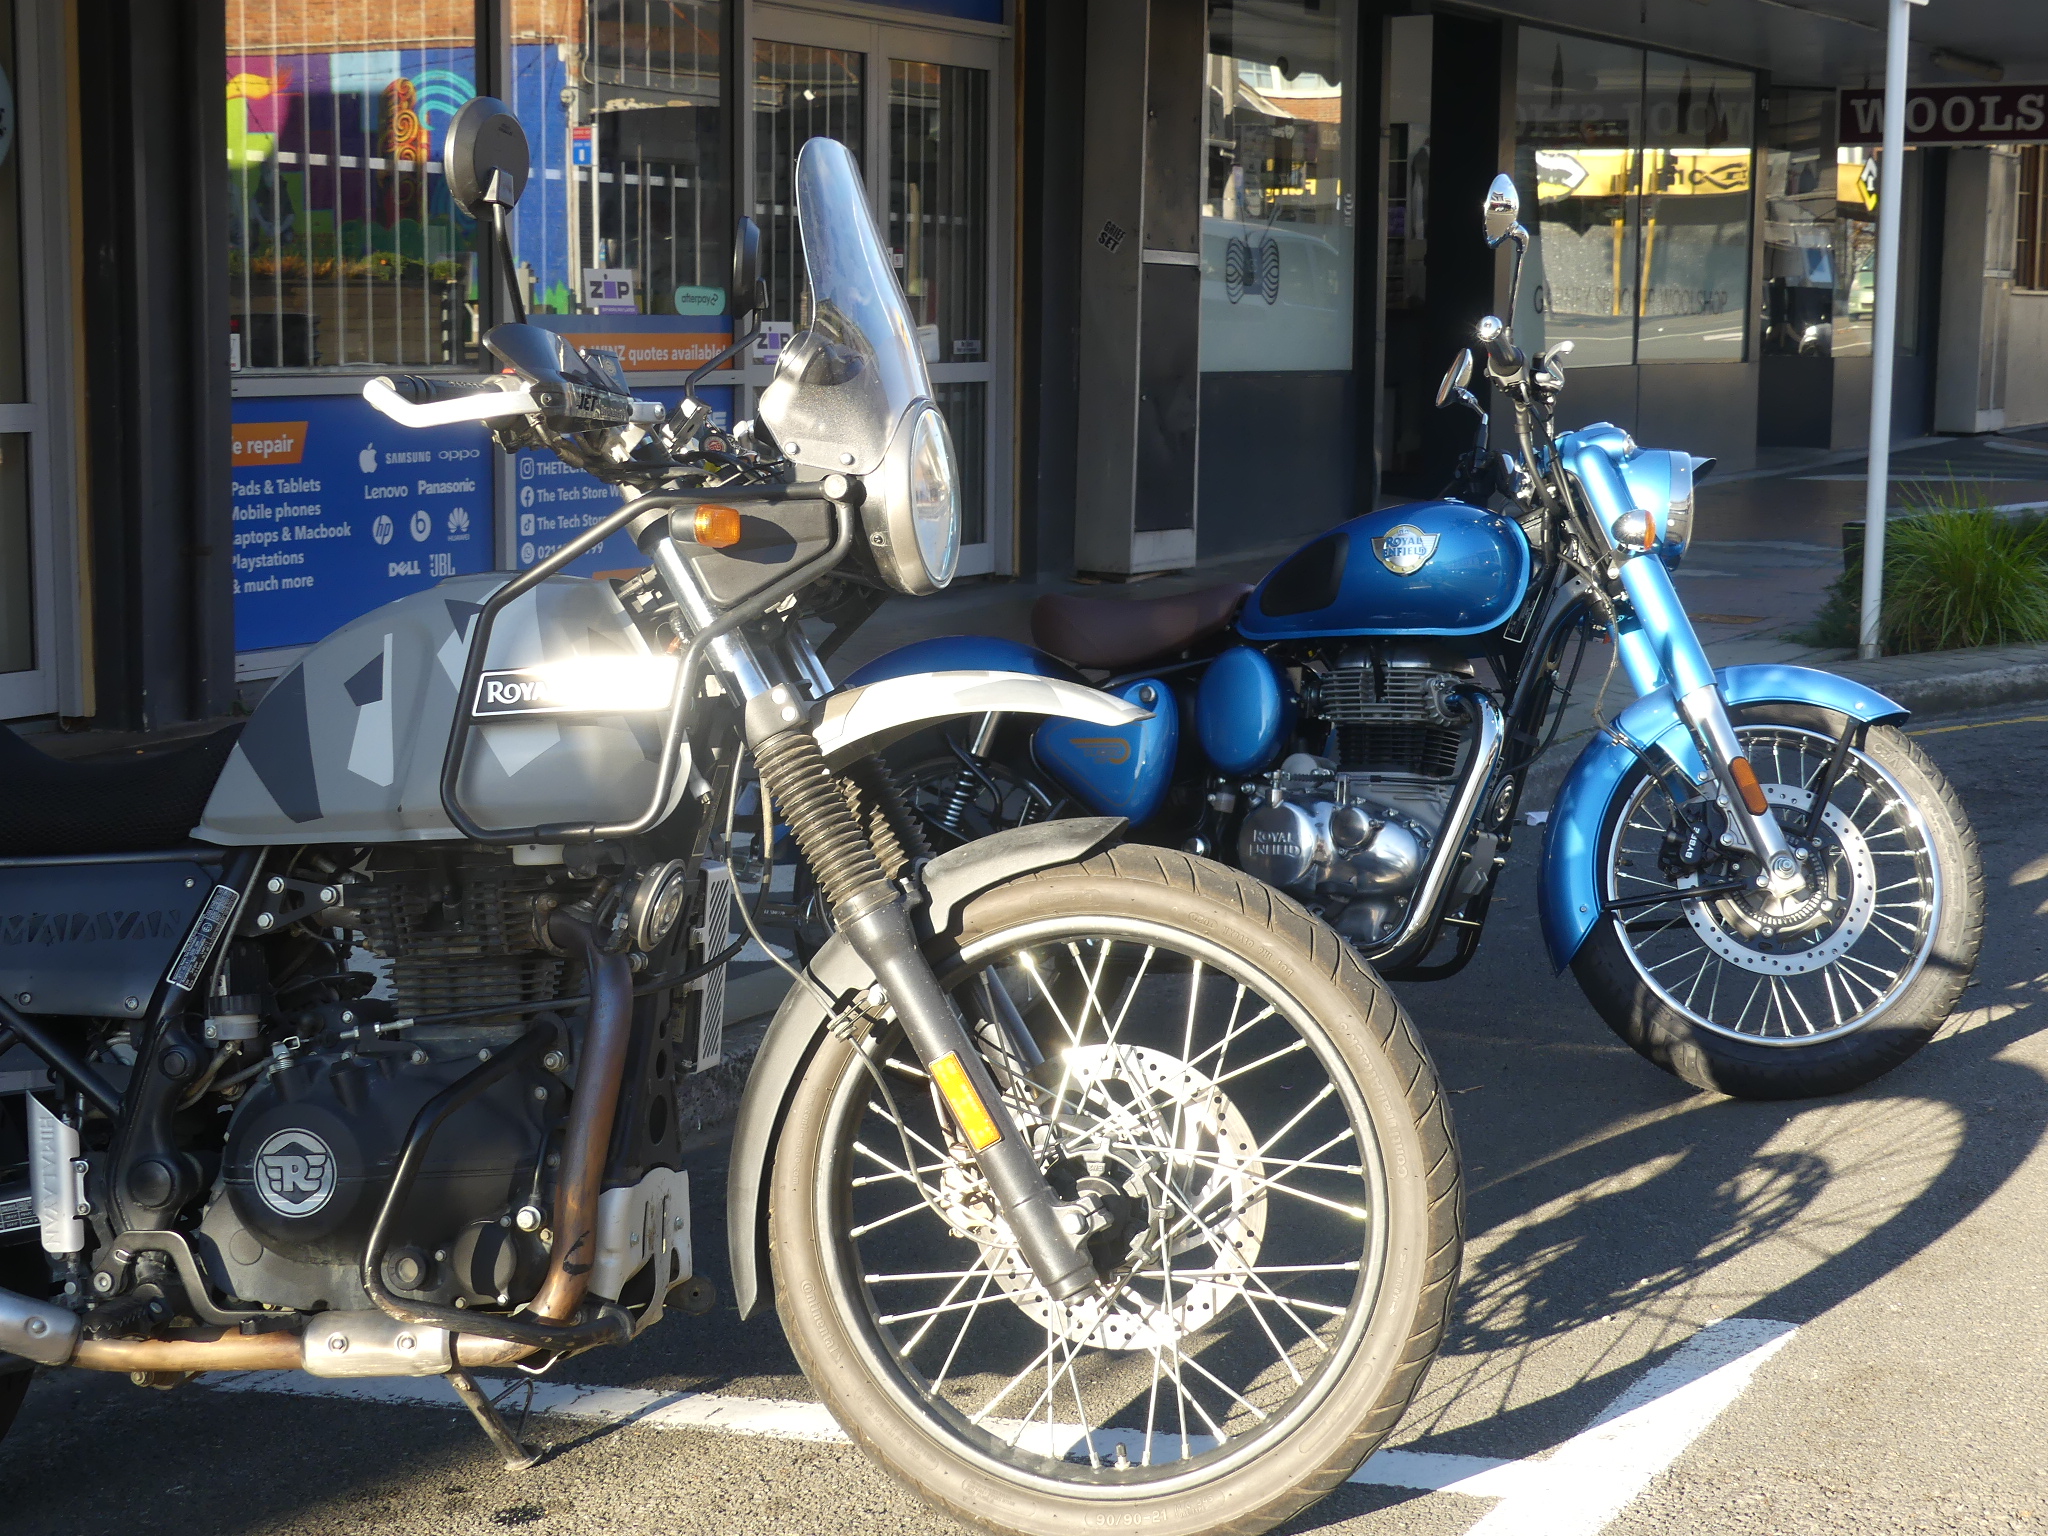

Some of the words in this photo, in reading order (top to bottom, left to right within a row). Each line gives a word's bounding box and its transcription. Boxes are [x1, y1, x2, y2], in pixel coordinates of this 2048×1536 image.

[1851, 94, 2045, 134] WOOLS
[1098, 232, 1120, 251] SET
[681, 293, 711, 306] afterpay
[628, 346, 669, 366] quotes
[577, 393, 598, 411] JET
[247, 434, 294, 459] repair
[385, 450, 431, 464] SAMSUNG
[438, 449, 481, 461] oppo
[264, 479, 274, 494] &
[276, 477, 321, 494] Tablets
[364, 484, 409, 500] Lenovo
[418, 477, 476, 495] Panasonic
[537, 489, 555, 502] The
[557, 486, 580, 501] Tech
[581, 485, 608, 500] Store
[275, 502, 321, 522] phones
[537, 517, 555, 530] The
[557, 514, 580, 529] Tech
[233, 531, 279, 549] aptops
[281, 526, 292, 541] &
[294, 521, 352, 541] Macbook
[1385, 536, 1424, 549] ROYAL
[1383, 546, 1428, 559] ENFIELD
[388, 560, 421, 577] DELL
[430, 553, 456, 577] JBL
[244, 574, 279, 593] much
[281, 575, 315, 591] more
[486, 680, 552, 704] ROYA
[1253, 829, 1293, 843] ROYAL
[1249, 844, 1302, 858] ENFIELD
[38, 1115, 61, 1247] HIMALAYAN
[1096, 1509, 1168, 1526] 90/90-21
